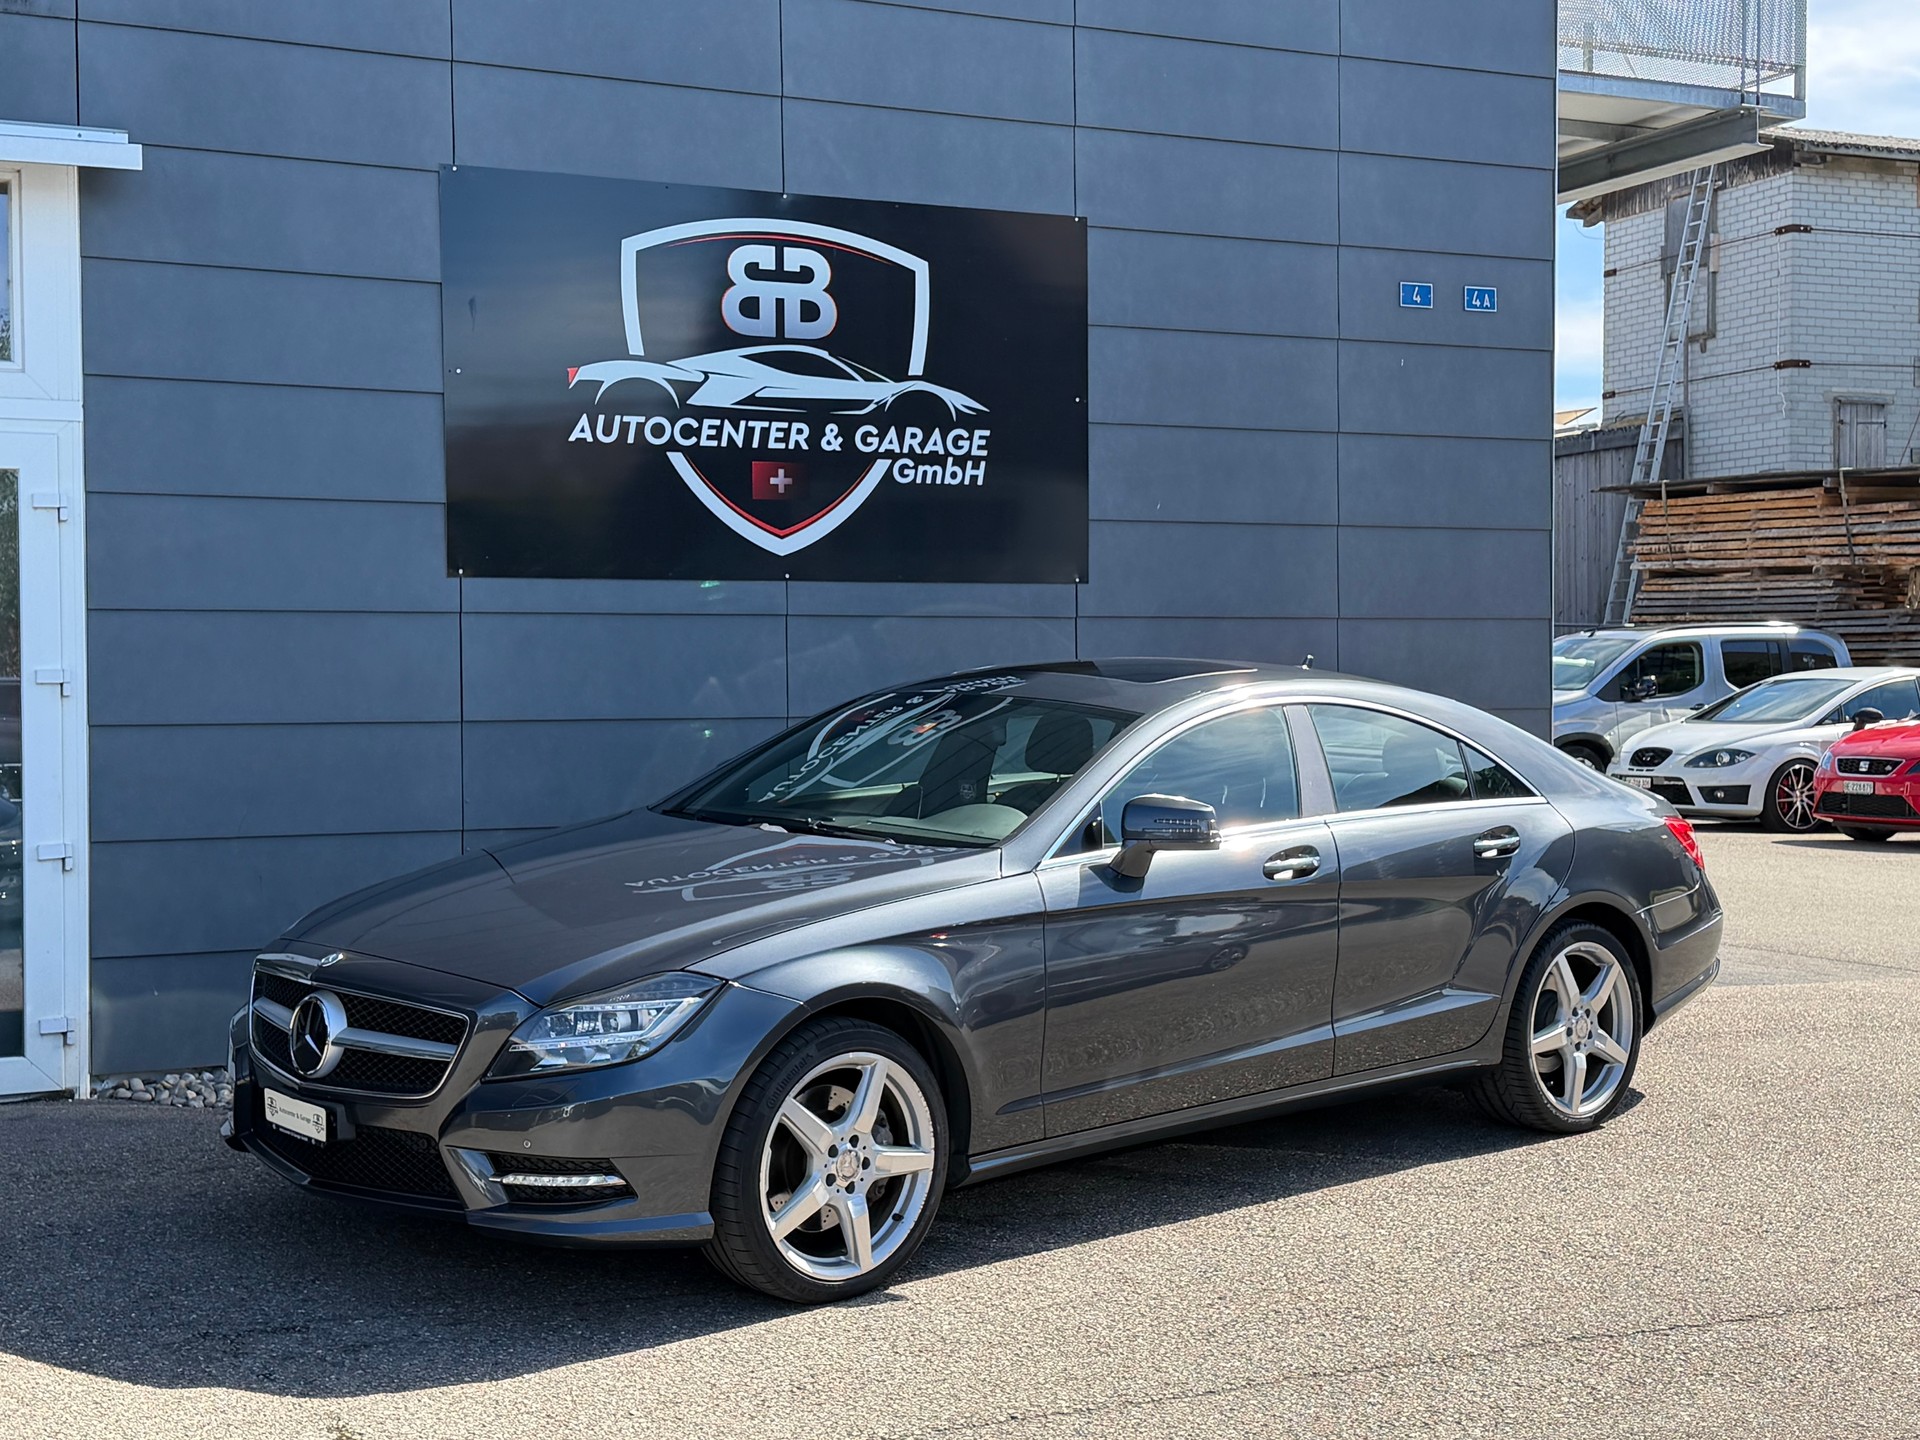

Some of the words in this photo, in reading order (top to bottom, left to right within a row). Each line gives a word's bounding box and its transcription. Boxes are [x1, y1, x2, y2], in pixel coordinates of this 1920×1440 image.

[1413, 286, 1421, 303] 4
[1472, 291, 1490, 308] 4A
[568, 412, 809, 451] AUTOCENTER
[820, 426, 843, 452] &
[854, 425, 991, 457] GARAGE
[892, 459, 986, 487] GmbH
